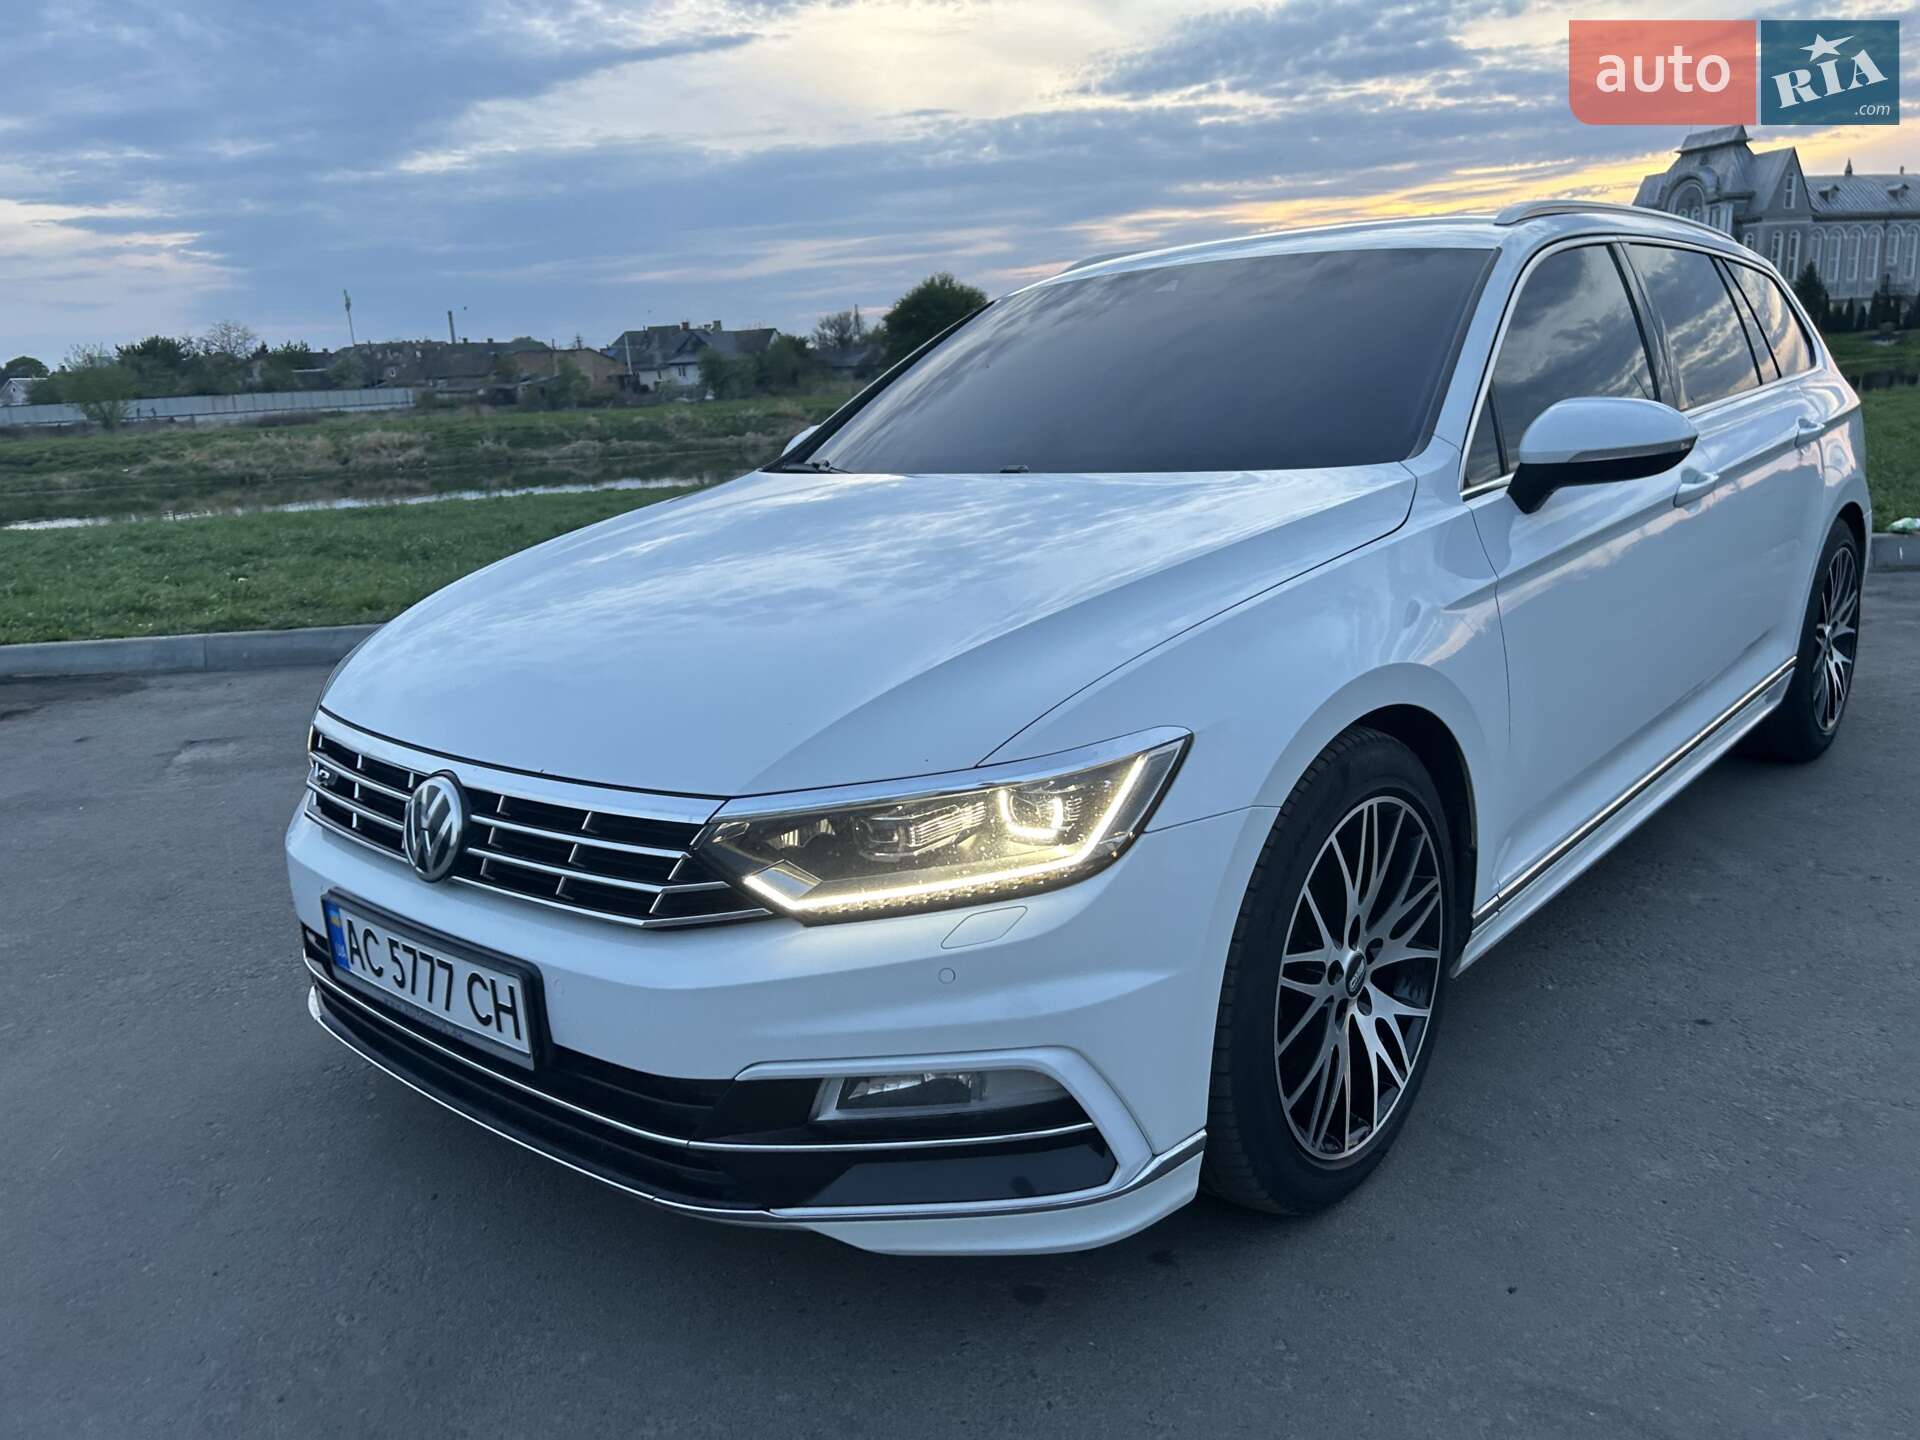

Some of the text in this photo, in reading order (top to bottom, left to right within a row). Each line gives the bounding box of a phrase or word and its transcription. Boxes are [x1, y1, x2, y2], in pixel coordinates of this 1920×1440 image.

[347, 919, 384, 978] AC
[387, 937, 454, 1012] 5777
[466, 972, 521, 1041] CH
